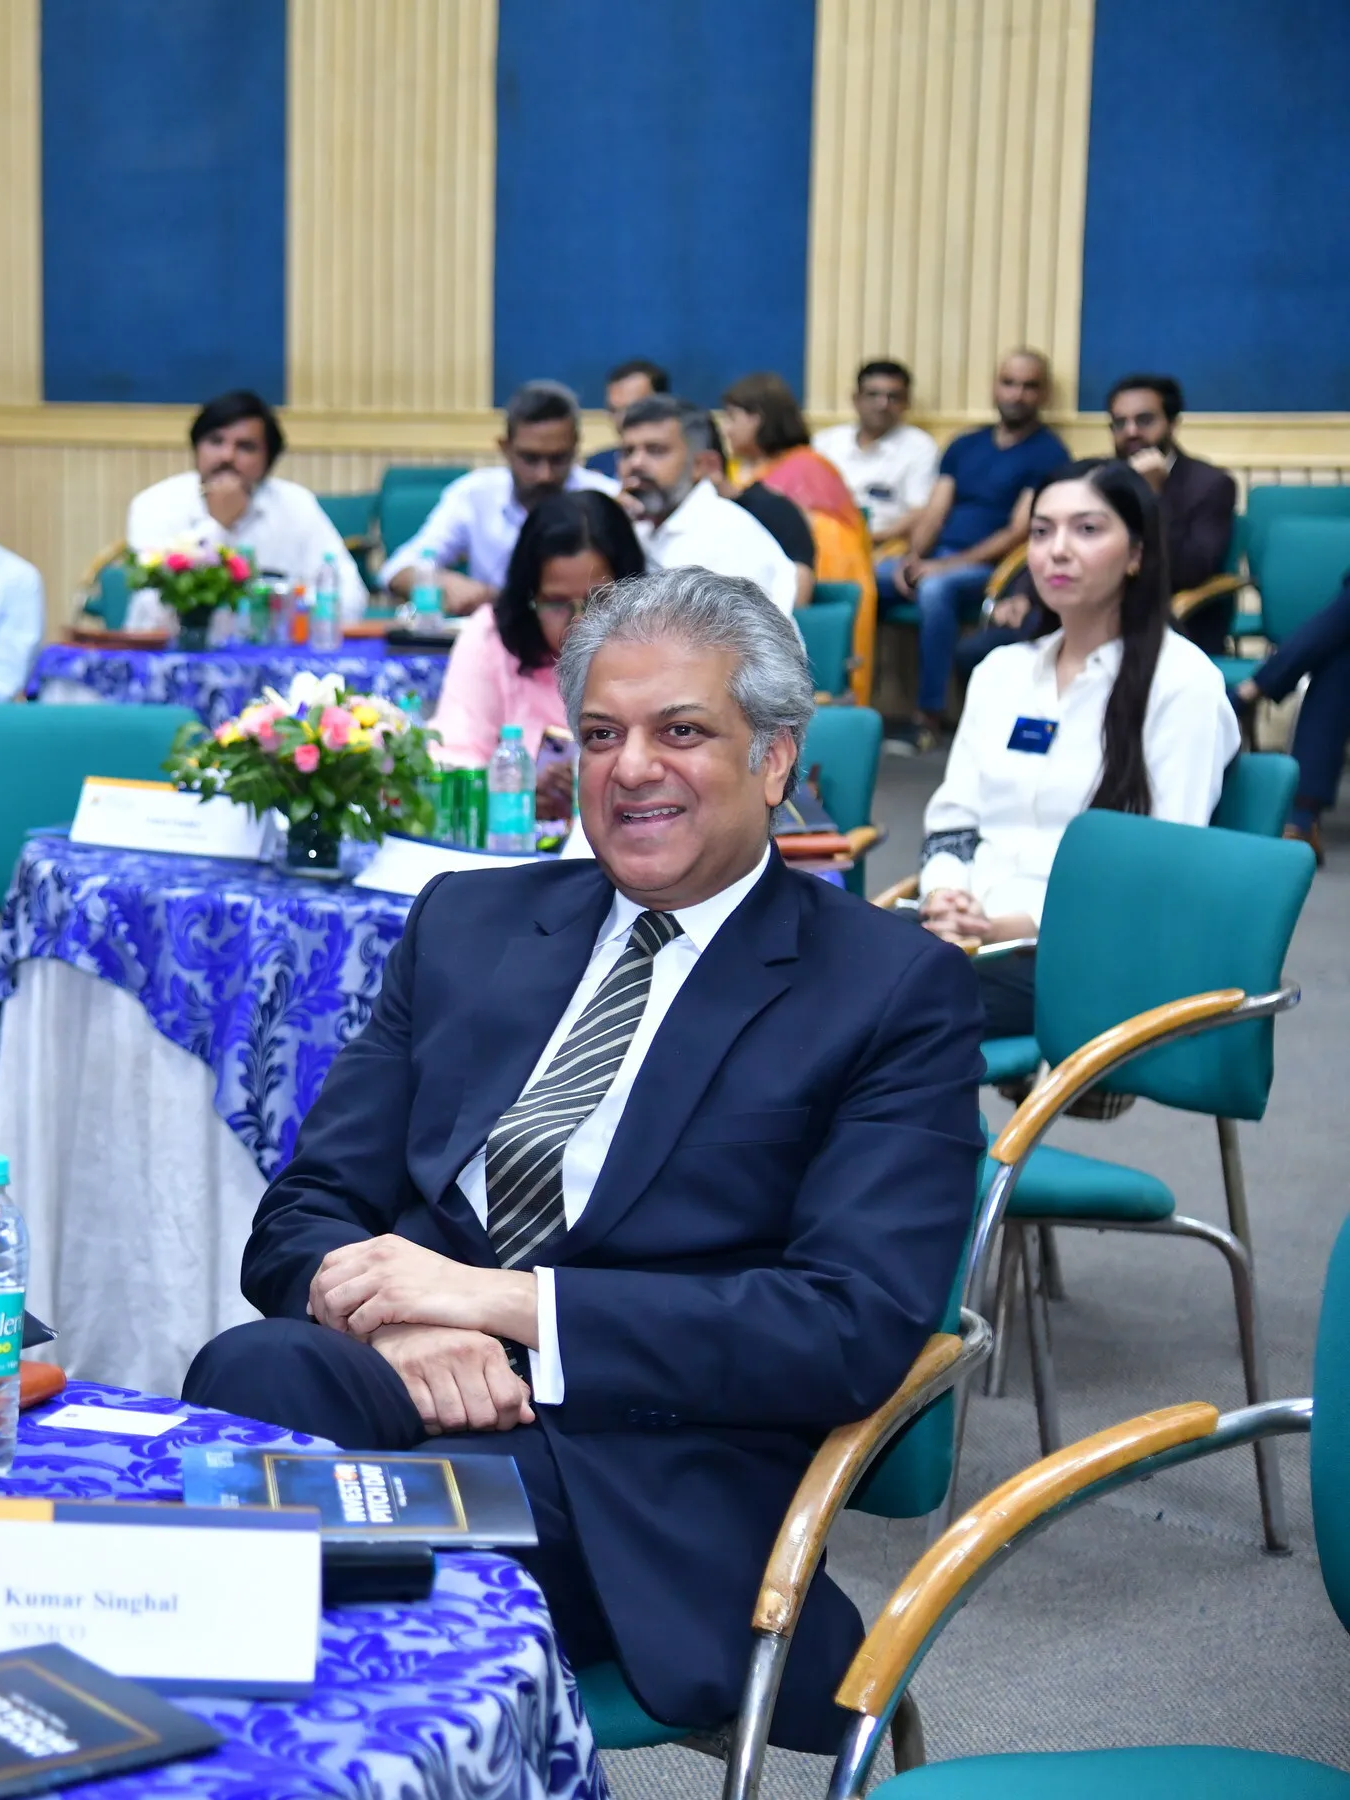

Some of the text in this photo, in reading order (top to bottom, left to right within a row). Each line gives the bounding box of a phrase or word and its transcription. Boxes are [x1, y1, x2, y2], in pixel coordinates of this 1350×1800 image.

[334, 1463, 367, 1522] INVESTOR
[364, 1486, 393, 1523] PITCH
[4, 1587, 83, 1609] Kumar
[93, 1590, 179, 1615] Singhal
